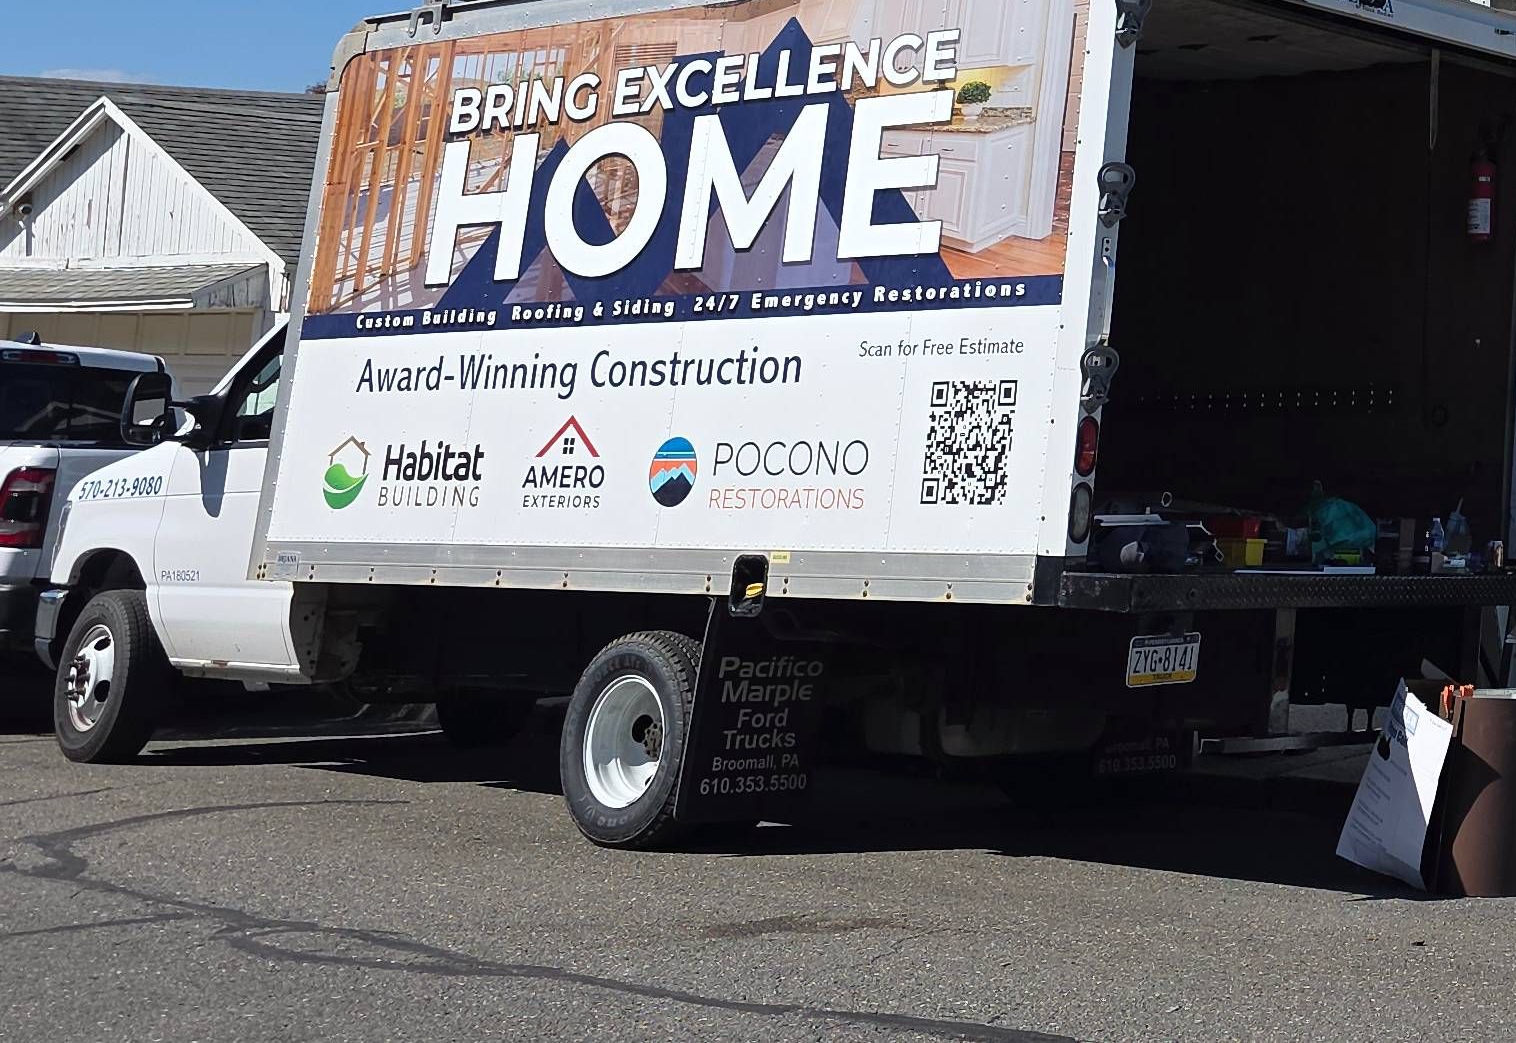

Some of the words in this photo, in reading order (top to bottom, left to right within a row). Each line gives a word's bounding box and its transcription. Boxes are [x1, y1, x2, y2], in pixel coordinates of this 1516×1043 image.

[449, 72, 601, 135] BRING
[613, 28, 961, 116] EXCELLENCE
[423, 89, 955, 288] HOME
[356, 314, 414, 330] Custom
[422, 308, 497, 328] Building
[511, 299, 584, 322] Roofing
[593, 301, 604, 317] &
[612, 298, 675, 318] Siding
[693, 294, 739, 313] 24/7
[751, 289, 863, 310] Emergency
[874, 281, 1026, 302] Restorations
[859, 340, 892, 357] Scan
[898, 339, 919, 358] for
[922, 339, 953, 356] Free
[959, 338, 1024, 355] Estimate
[355, 352, 578, 400] Award-Winning
[590, 346, 801, 388] Construction
[382, 440, 485, 482] Habitat
[713, 440, 869, 476] POCONO
[522, 465, 605, 488] AMERO
[79, 476, 162, 500] 570-213-9080
[378, 486, 480, 507] BUILDING
[709, 488, 864, 509] RESTORATIONS
[523, 495, 601, 508] EXTERIORS
[718, 656, 823, 678] Pacifico
[721, 679, 813, 707] Marple
[737, 708, 788, 728] Ford
[723, 729, 796, 750] Trucks
[712, 755, 777, 771] Broomall,
[781, 754, 799, 768] PA
[700, 774, 807, 795] 610.353.5500
